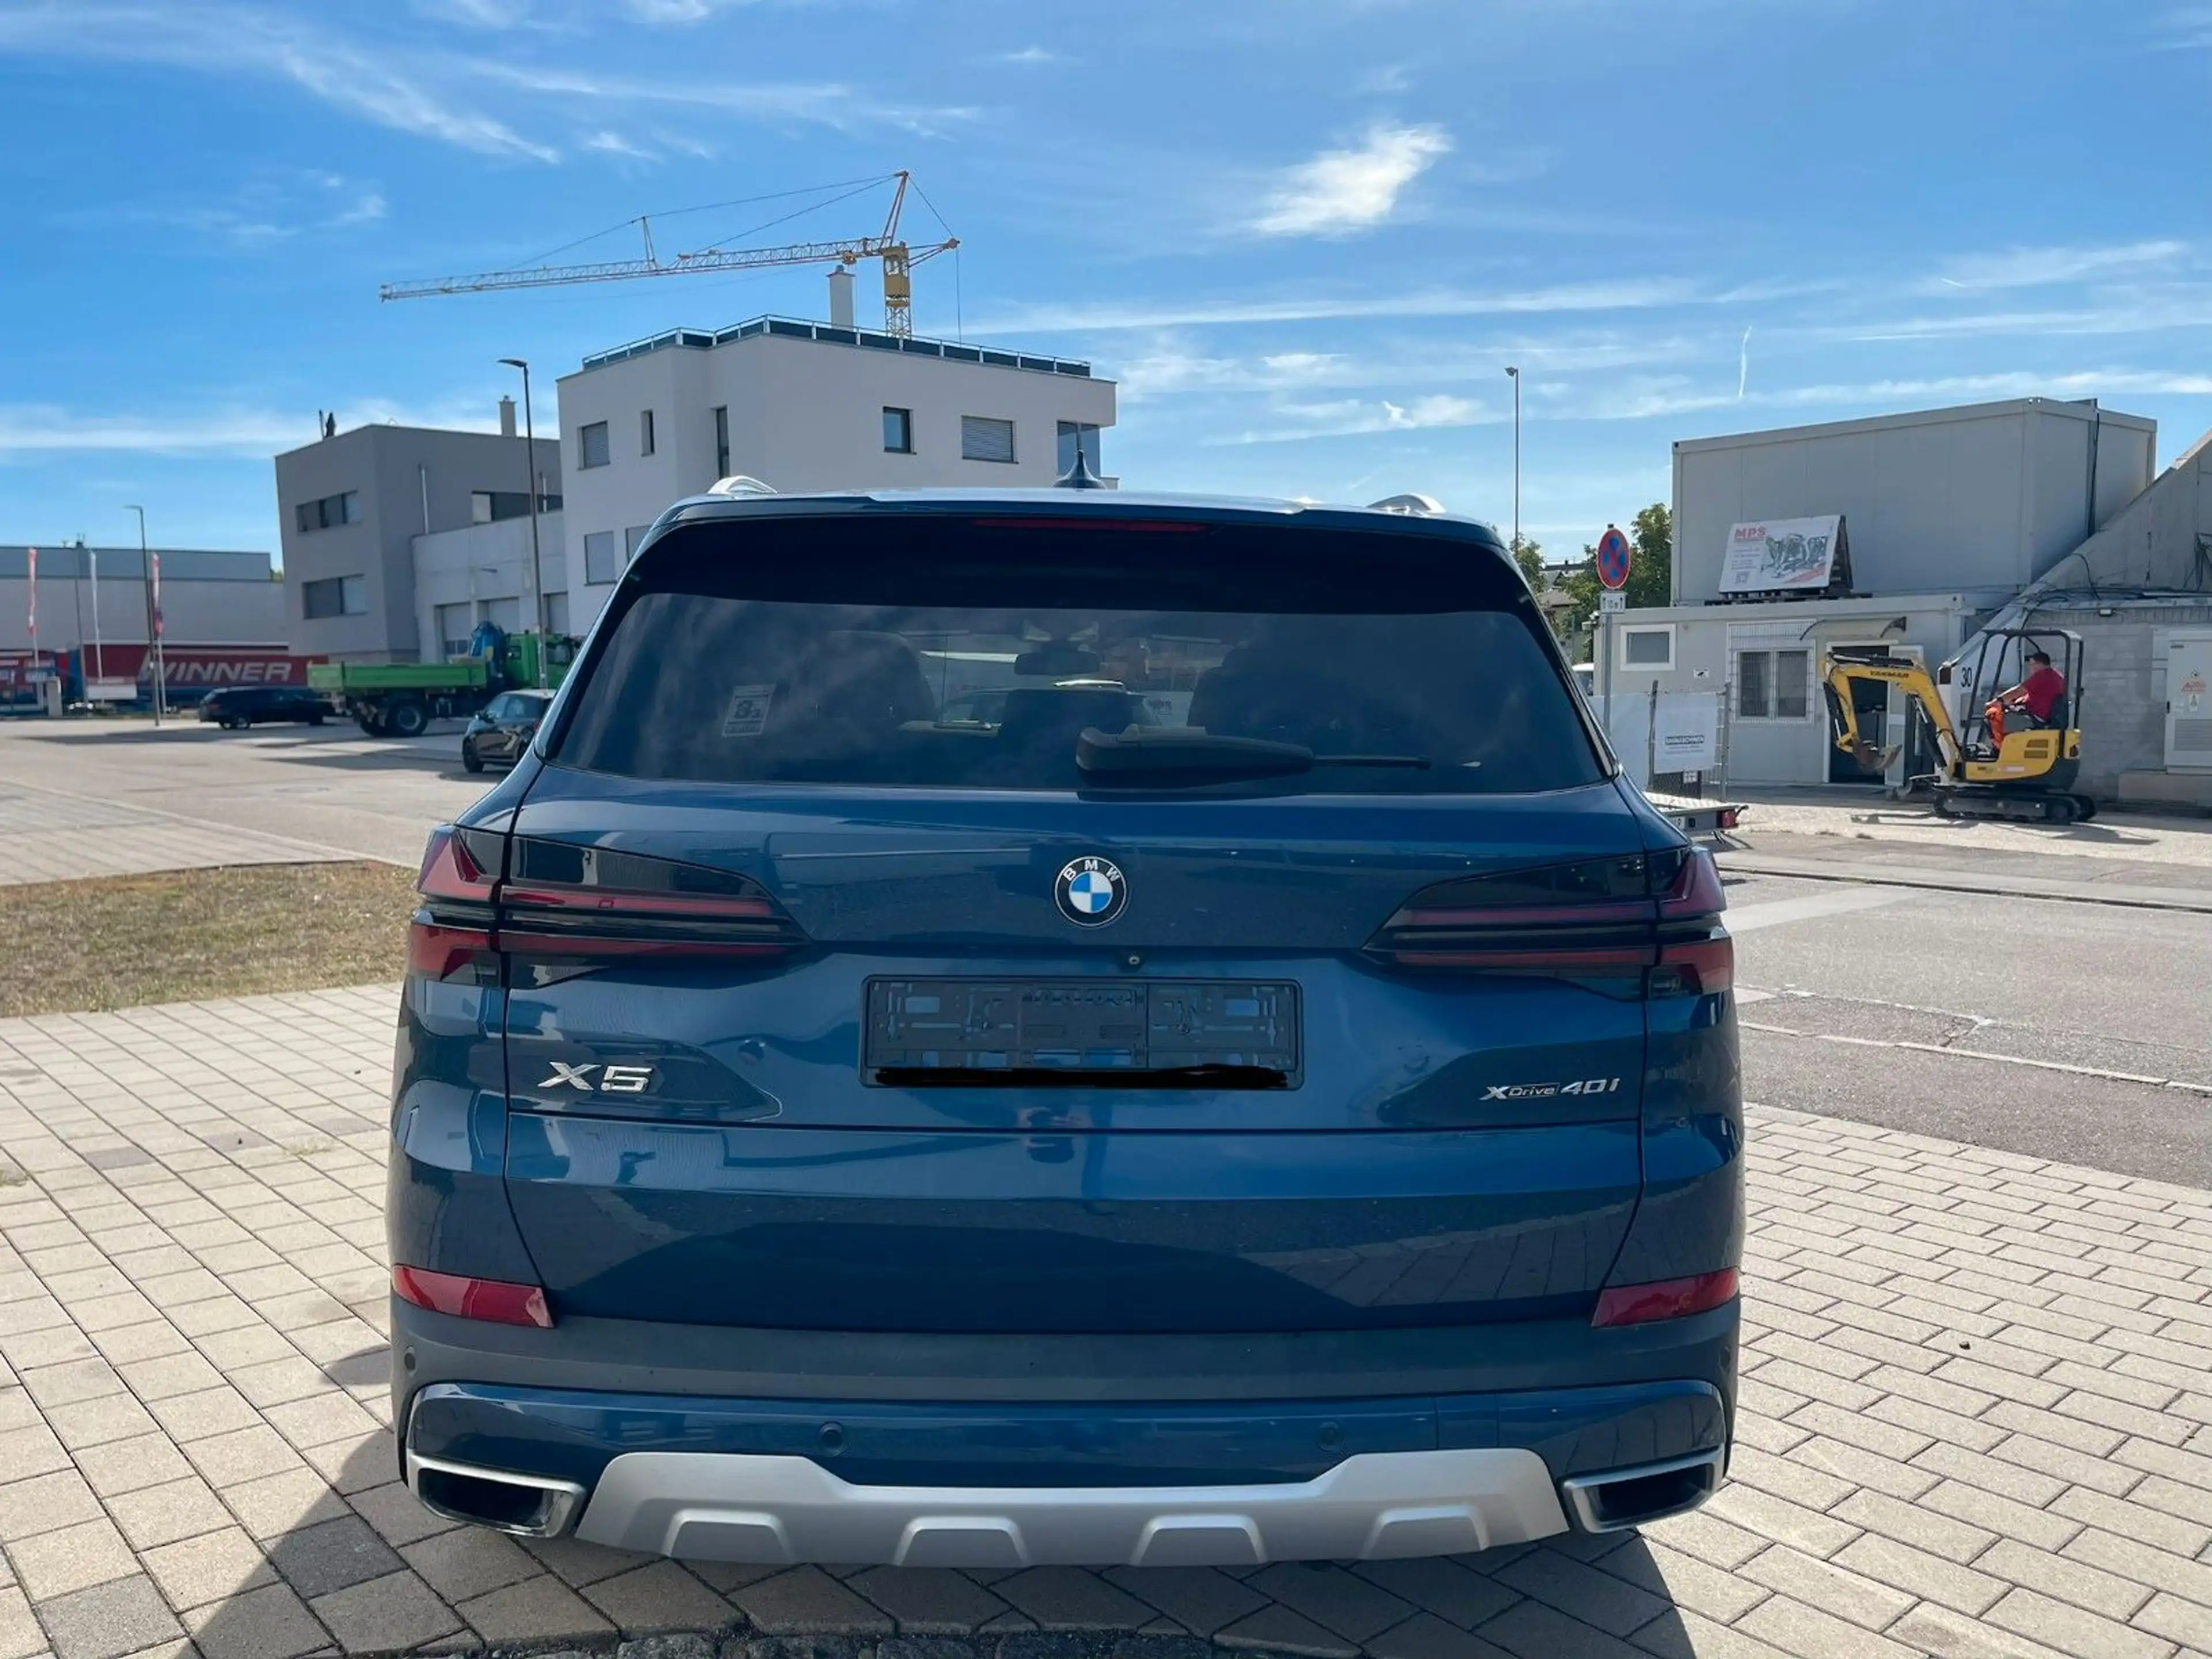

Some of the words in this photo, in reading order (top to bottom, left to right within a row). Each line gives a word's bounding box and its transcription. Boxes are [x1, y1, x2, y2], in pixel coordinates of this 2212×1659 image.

[1734, 525, 1767, 539] MPS
[1960, 666, 1972, 688] 30
[1063, 859, 1120, 882] BMW
[537, 1062, 653, 1093] X5
